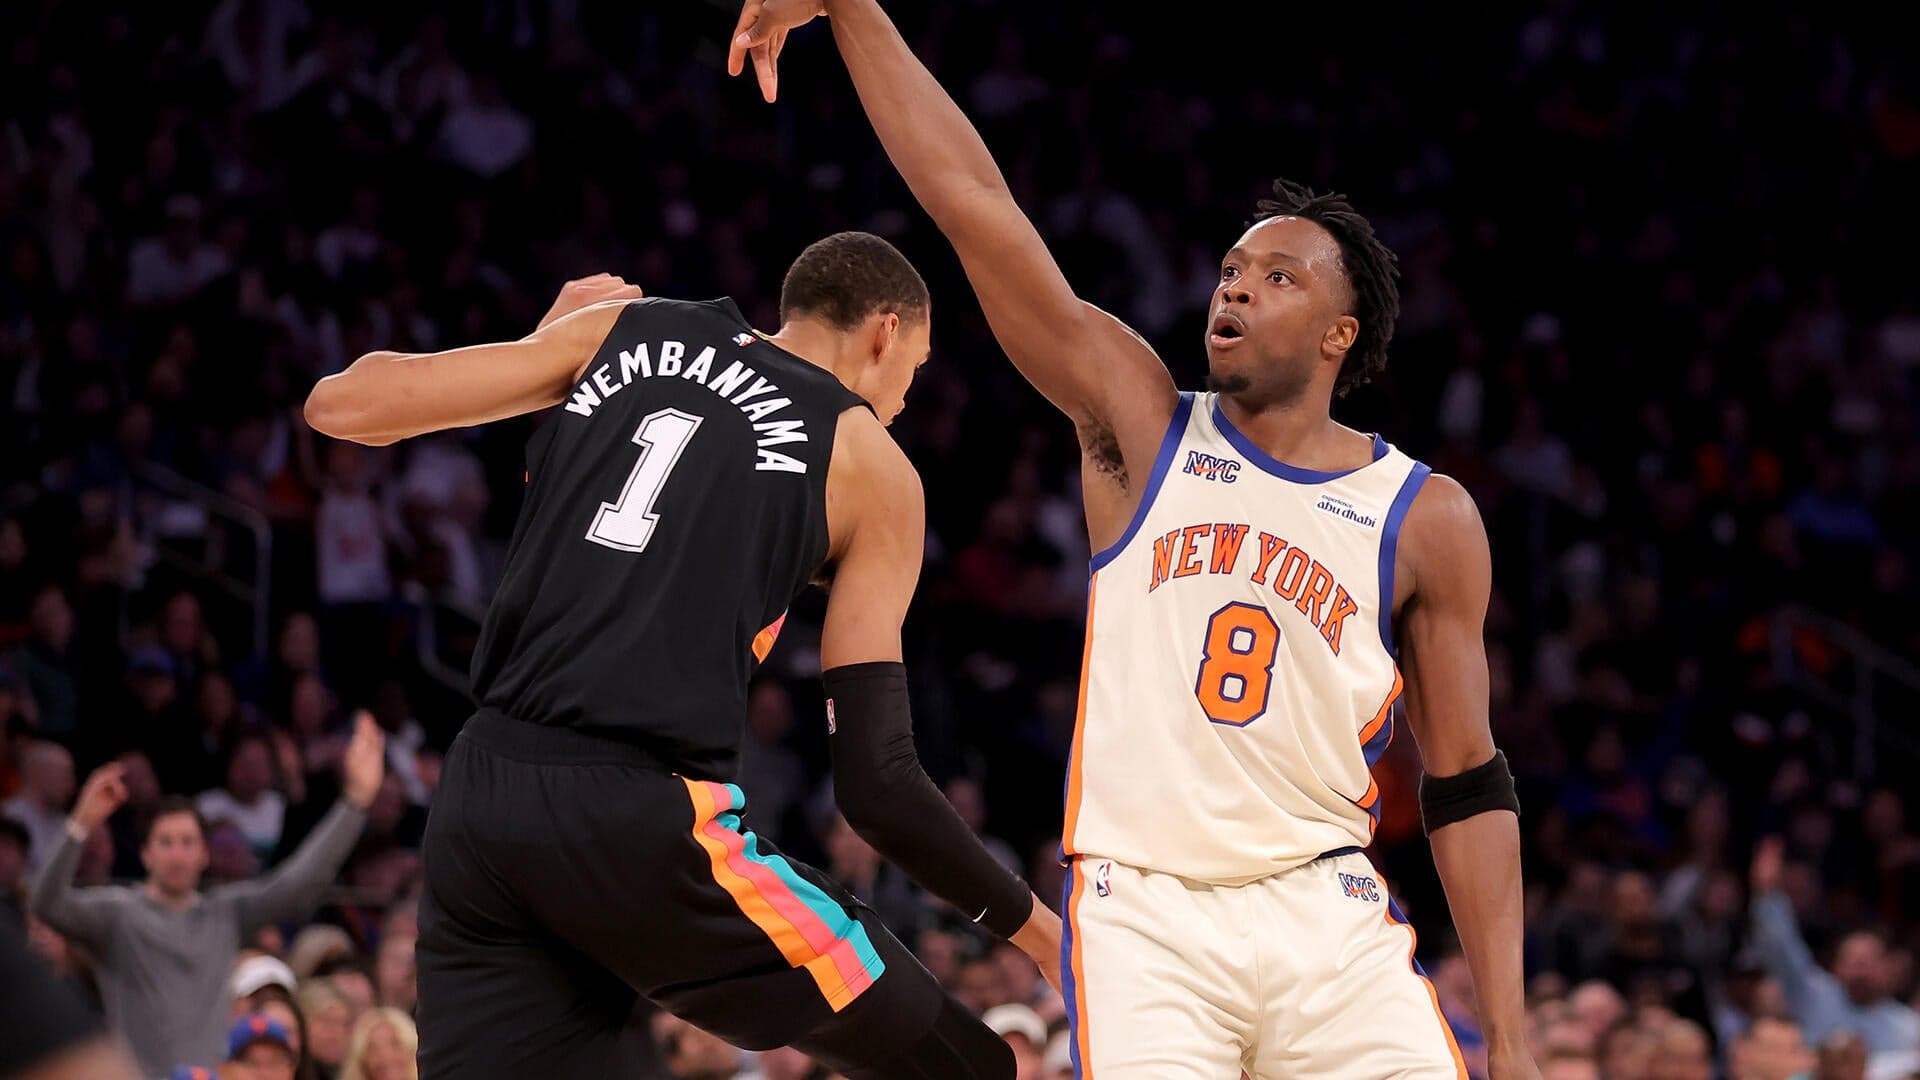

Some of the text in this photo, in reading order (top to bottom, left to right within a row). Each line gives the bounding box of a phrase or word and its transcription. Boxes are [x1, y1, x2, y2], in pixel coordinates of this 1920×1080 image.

[564, 340, 809, 474] WEMBANYAMA
[1183, 450, 1241, 483] NYC
[584, 407, 705, 553] 1
[1317, 501, 1377, 528] abu dhabi
[1149, 523, 1358, 657] NEW YORK
[1195, 600, 1280, 727] 8
[1338, 872, 1380, 902] NYC
